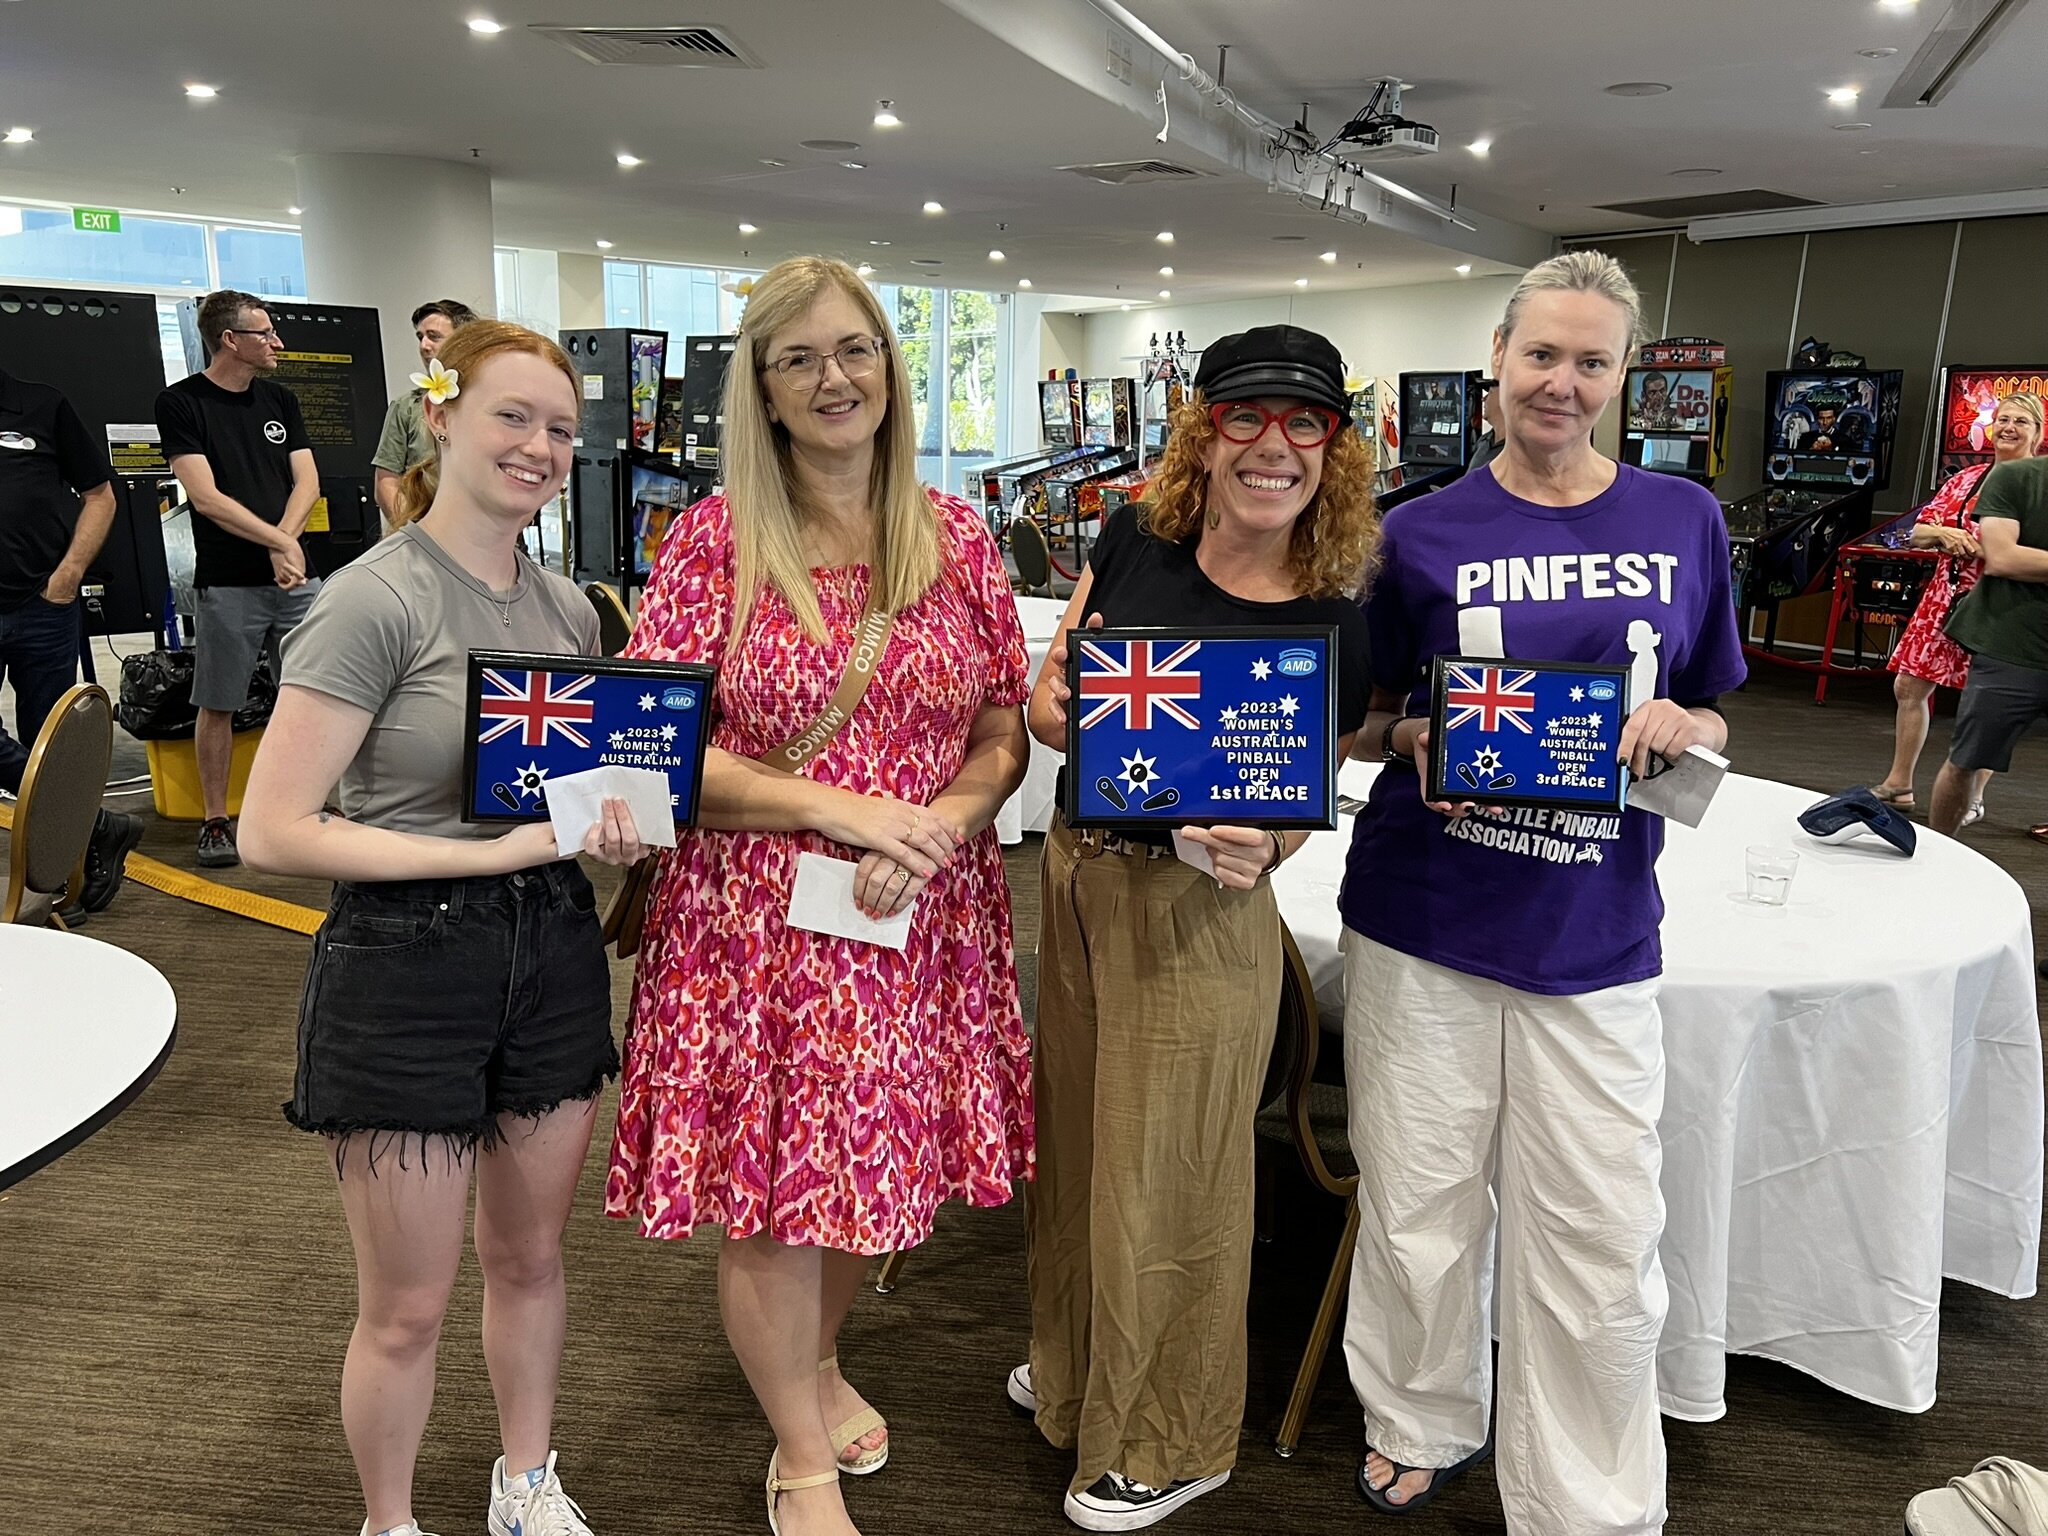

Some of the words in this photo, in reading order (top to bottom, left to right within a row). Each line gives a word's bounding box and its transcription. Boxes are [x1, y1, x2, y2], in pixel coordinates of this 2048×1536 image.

[82, 212, 111, 230] EXIT
[1655, 351, 1669, 360] SCAN
[1684, 350, 1697, 359] PLAY
[1676, 401, 1709, 418] NO
[1457, 553, 1678, 605] PINFEST
[854, 609, 888, 673] MIMCO
[1283, 660, 1313, 672] AMD
[1591, 689, 1613, 698] AMD
[665, 696, 692, 707] AMD
[1240, 702, 1278, 714] 2023
[1224, 719, 1294, 731] WOMEN'S
[1561, 716, 1587, 726] 2023
[627, 727, 659, 738] 2023
[785, 704, 845, 762] MIMCO
[1550, 727, 1598, 738] WOMEN'S
[612, 740, 671, 752] WOMEN'S
[1211, 736, 1307, 748] AUSTRALIAN
[1540, 738, 1607, 751] AUSTRALIAN
[599, 753, 681, 766] AUSTRALIAN
[1227, 752, 1292, 764] PINBALL
[1550, 750, 1595, 762] PINBALL
[1557, 762, 1586, 773] OPEN
[1238, 768, 1279, 780] OPEN
[1536, 773, 1559, 785] 3rd
[1562, 774, 1606, 788] PLACE
[1210, 785, 1241, 800] 1st
[1245, 785, 1308, 801] PLACE
[1551, 811, 1620, 839] PINBALL
[1444, 816, 1576, 864] ASSOCIATION
